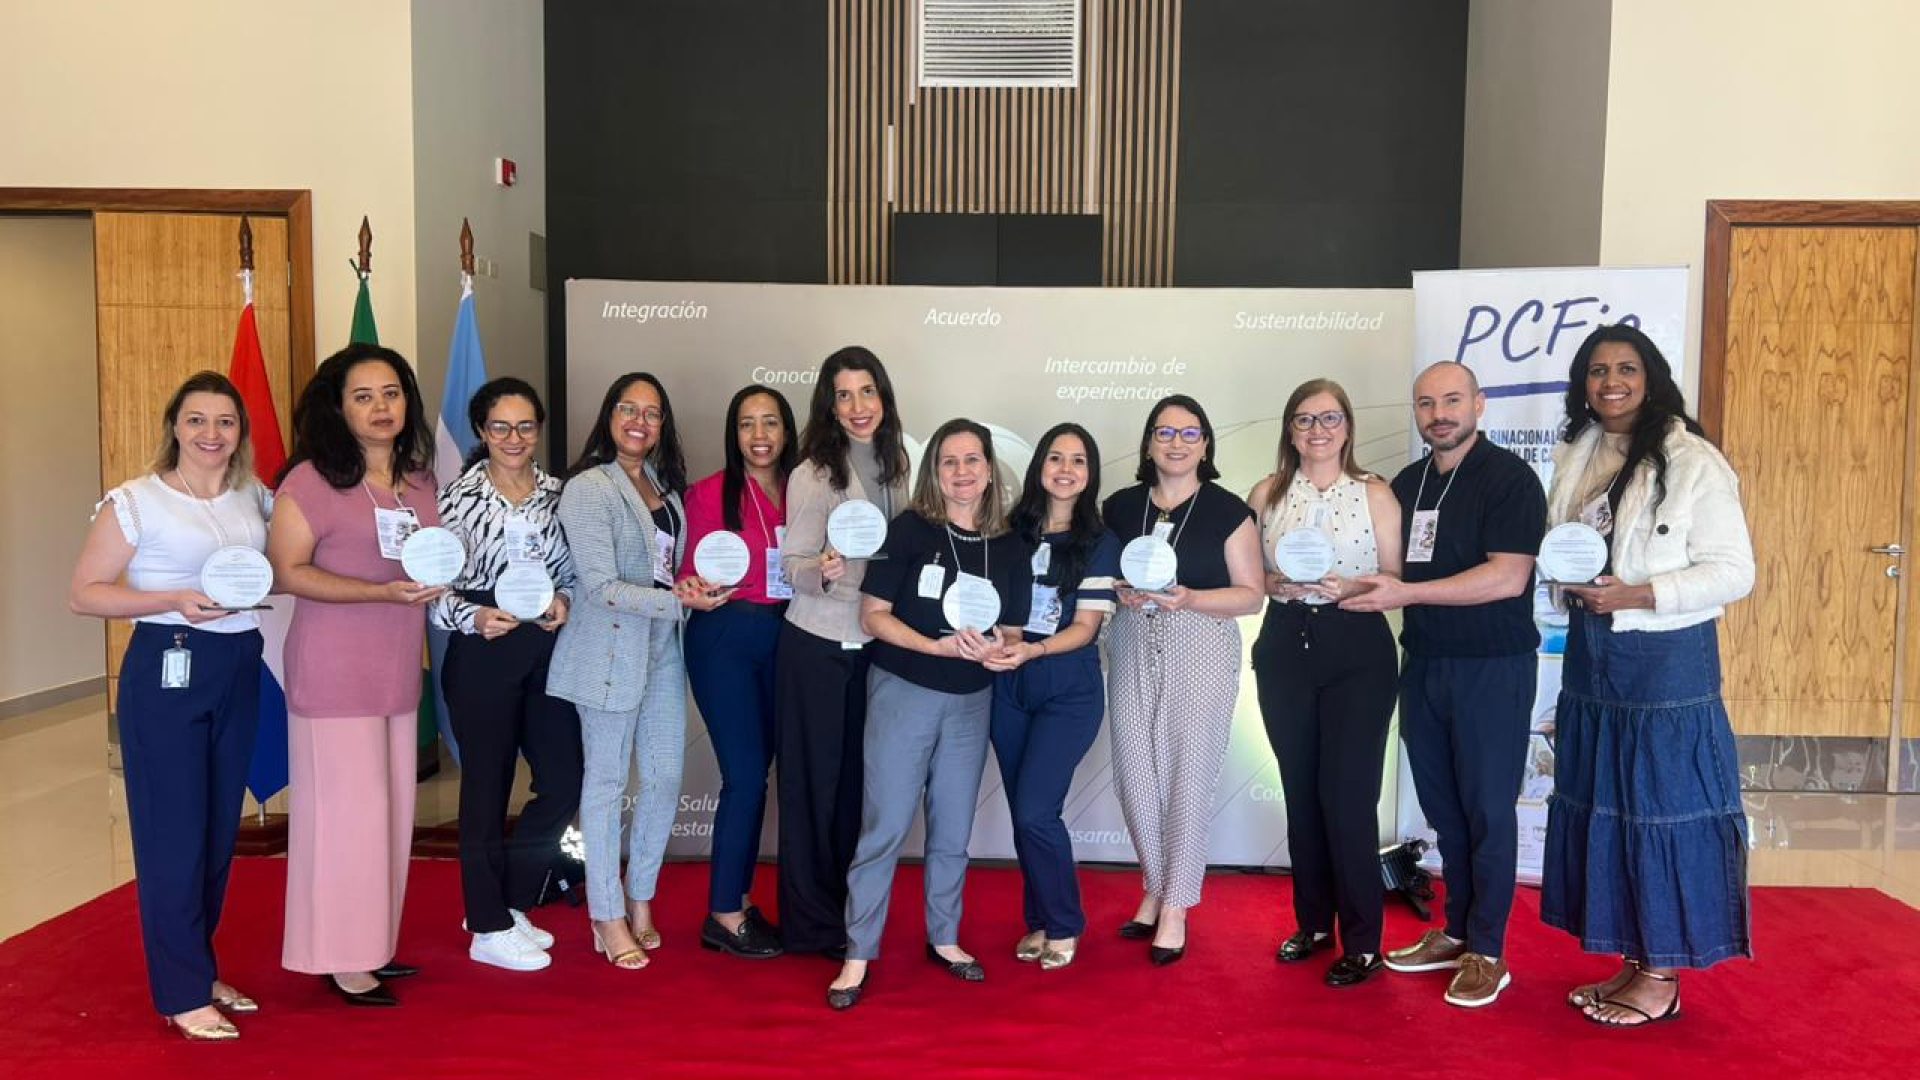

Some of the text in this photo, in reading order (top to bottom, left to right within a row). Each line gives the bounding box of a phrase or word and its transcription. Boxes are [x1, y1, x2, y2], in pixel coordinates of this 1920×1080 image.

[602, 300, 708, 323] Integración
[924, 306, 1002, 327] Acuerdo
[1233, 310, 1384, 331] Sustentabilidad
[1456, 296, 1641, 363] PCF
[1044, 356, 1187, 376] Intercambio de
[1055, 381, 1175, 405] experiencias
[679, 793, 720, 812] Salu
